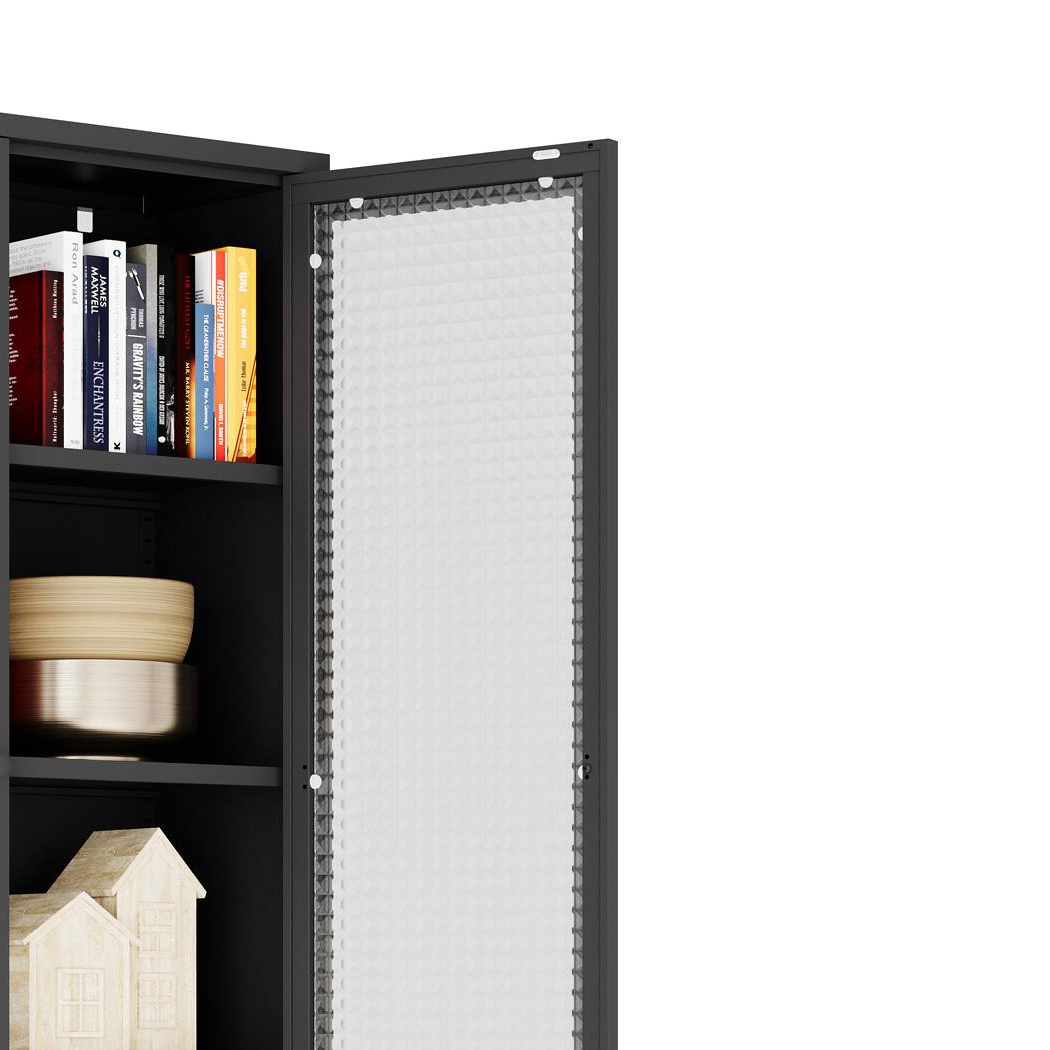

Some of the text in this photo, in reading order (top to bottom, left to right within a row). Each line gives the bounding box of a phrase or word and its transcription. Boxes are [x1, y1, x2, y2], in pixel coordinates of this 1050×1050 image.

[71, 275, 79, 305] Arad
[91, 266, 99, 314] MAXWELL
[99, 274, 107, 307] JAMES
[216, 279, 225, 358] #DISRUPTMENOW
[93, 361, 104, 444] ENCHANTRESS
[132, 342, 144, 436] GRAVITY'S RAINBOW
